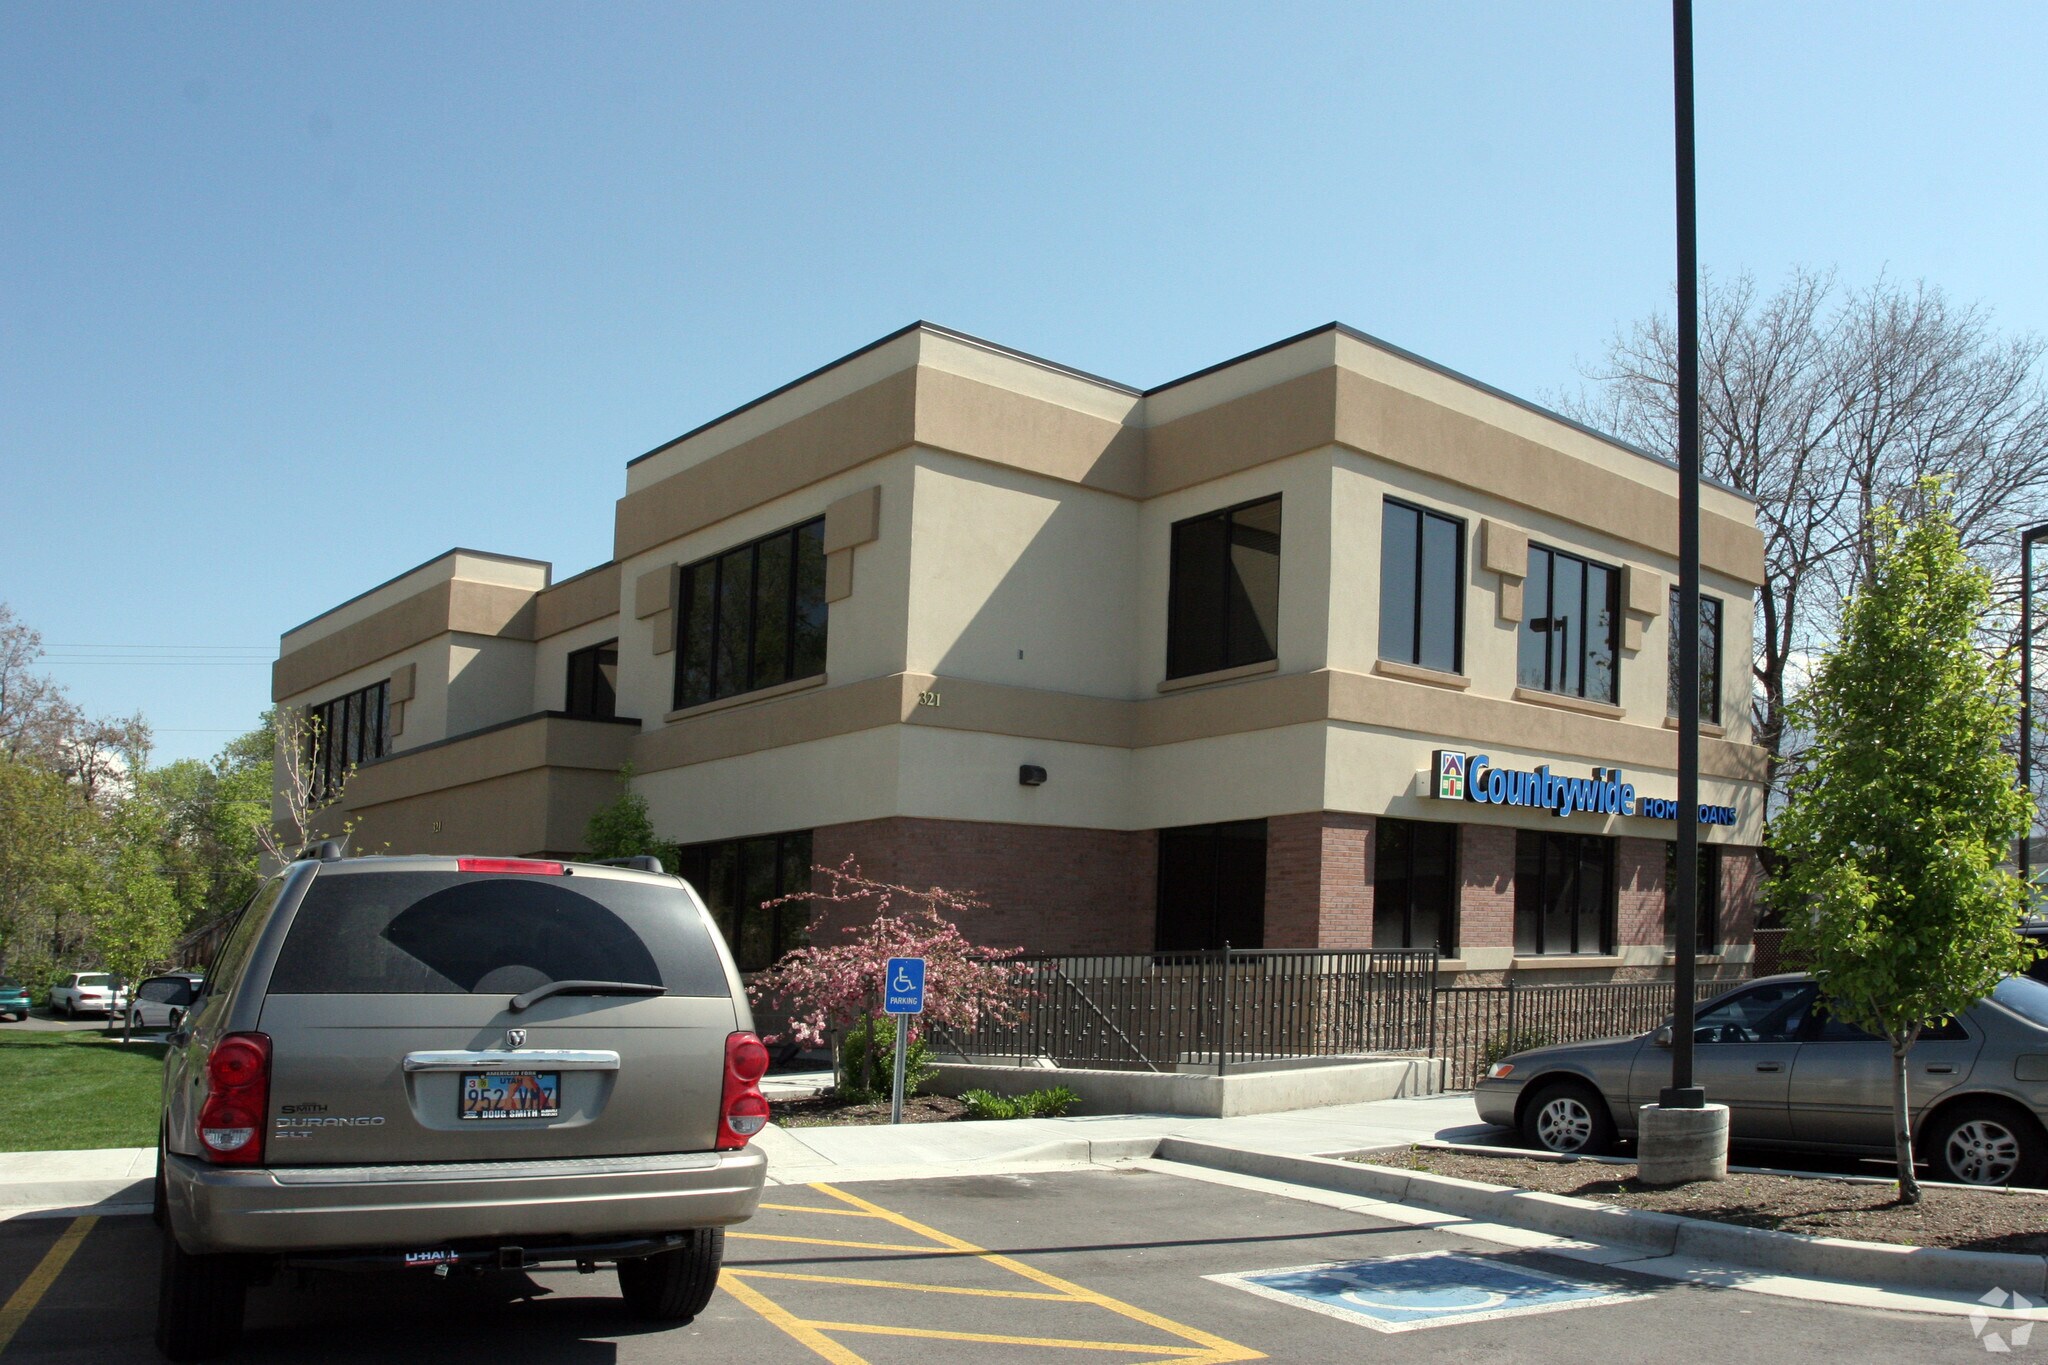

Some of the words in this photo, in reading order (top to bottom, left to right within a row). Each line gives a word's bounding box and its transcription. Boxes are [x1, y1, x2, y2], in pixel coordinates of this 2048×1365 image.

[919, 691, 941, 707] 321
[1467, 754, 1636, 818] Countrywide
[1643, 798, 1681, 820] HOM
[1696, 804, 1737, 826] OANS
[890, 996, 917, 1005] PARKING
[468, 1089, 504, 1110] 952
[281, 1103, 328, 1114] SMITH
[482, 1110, 506, 1118] DOUG
[509, 1110, 538, 1118] SMITH
[276, 1116, 386, 1128] DURANGO
